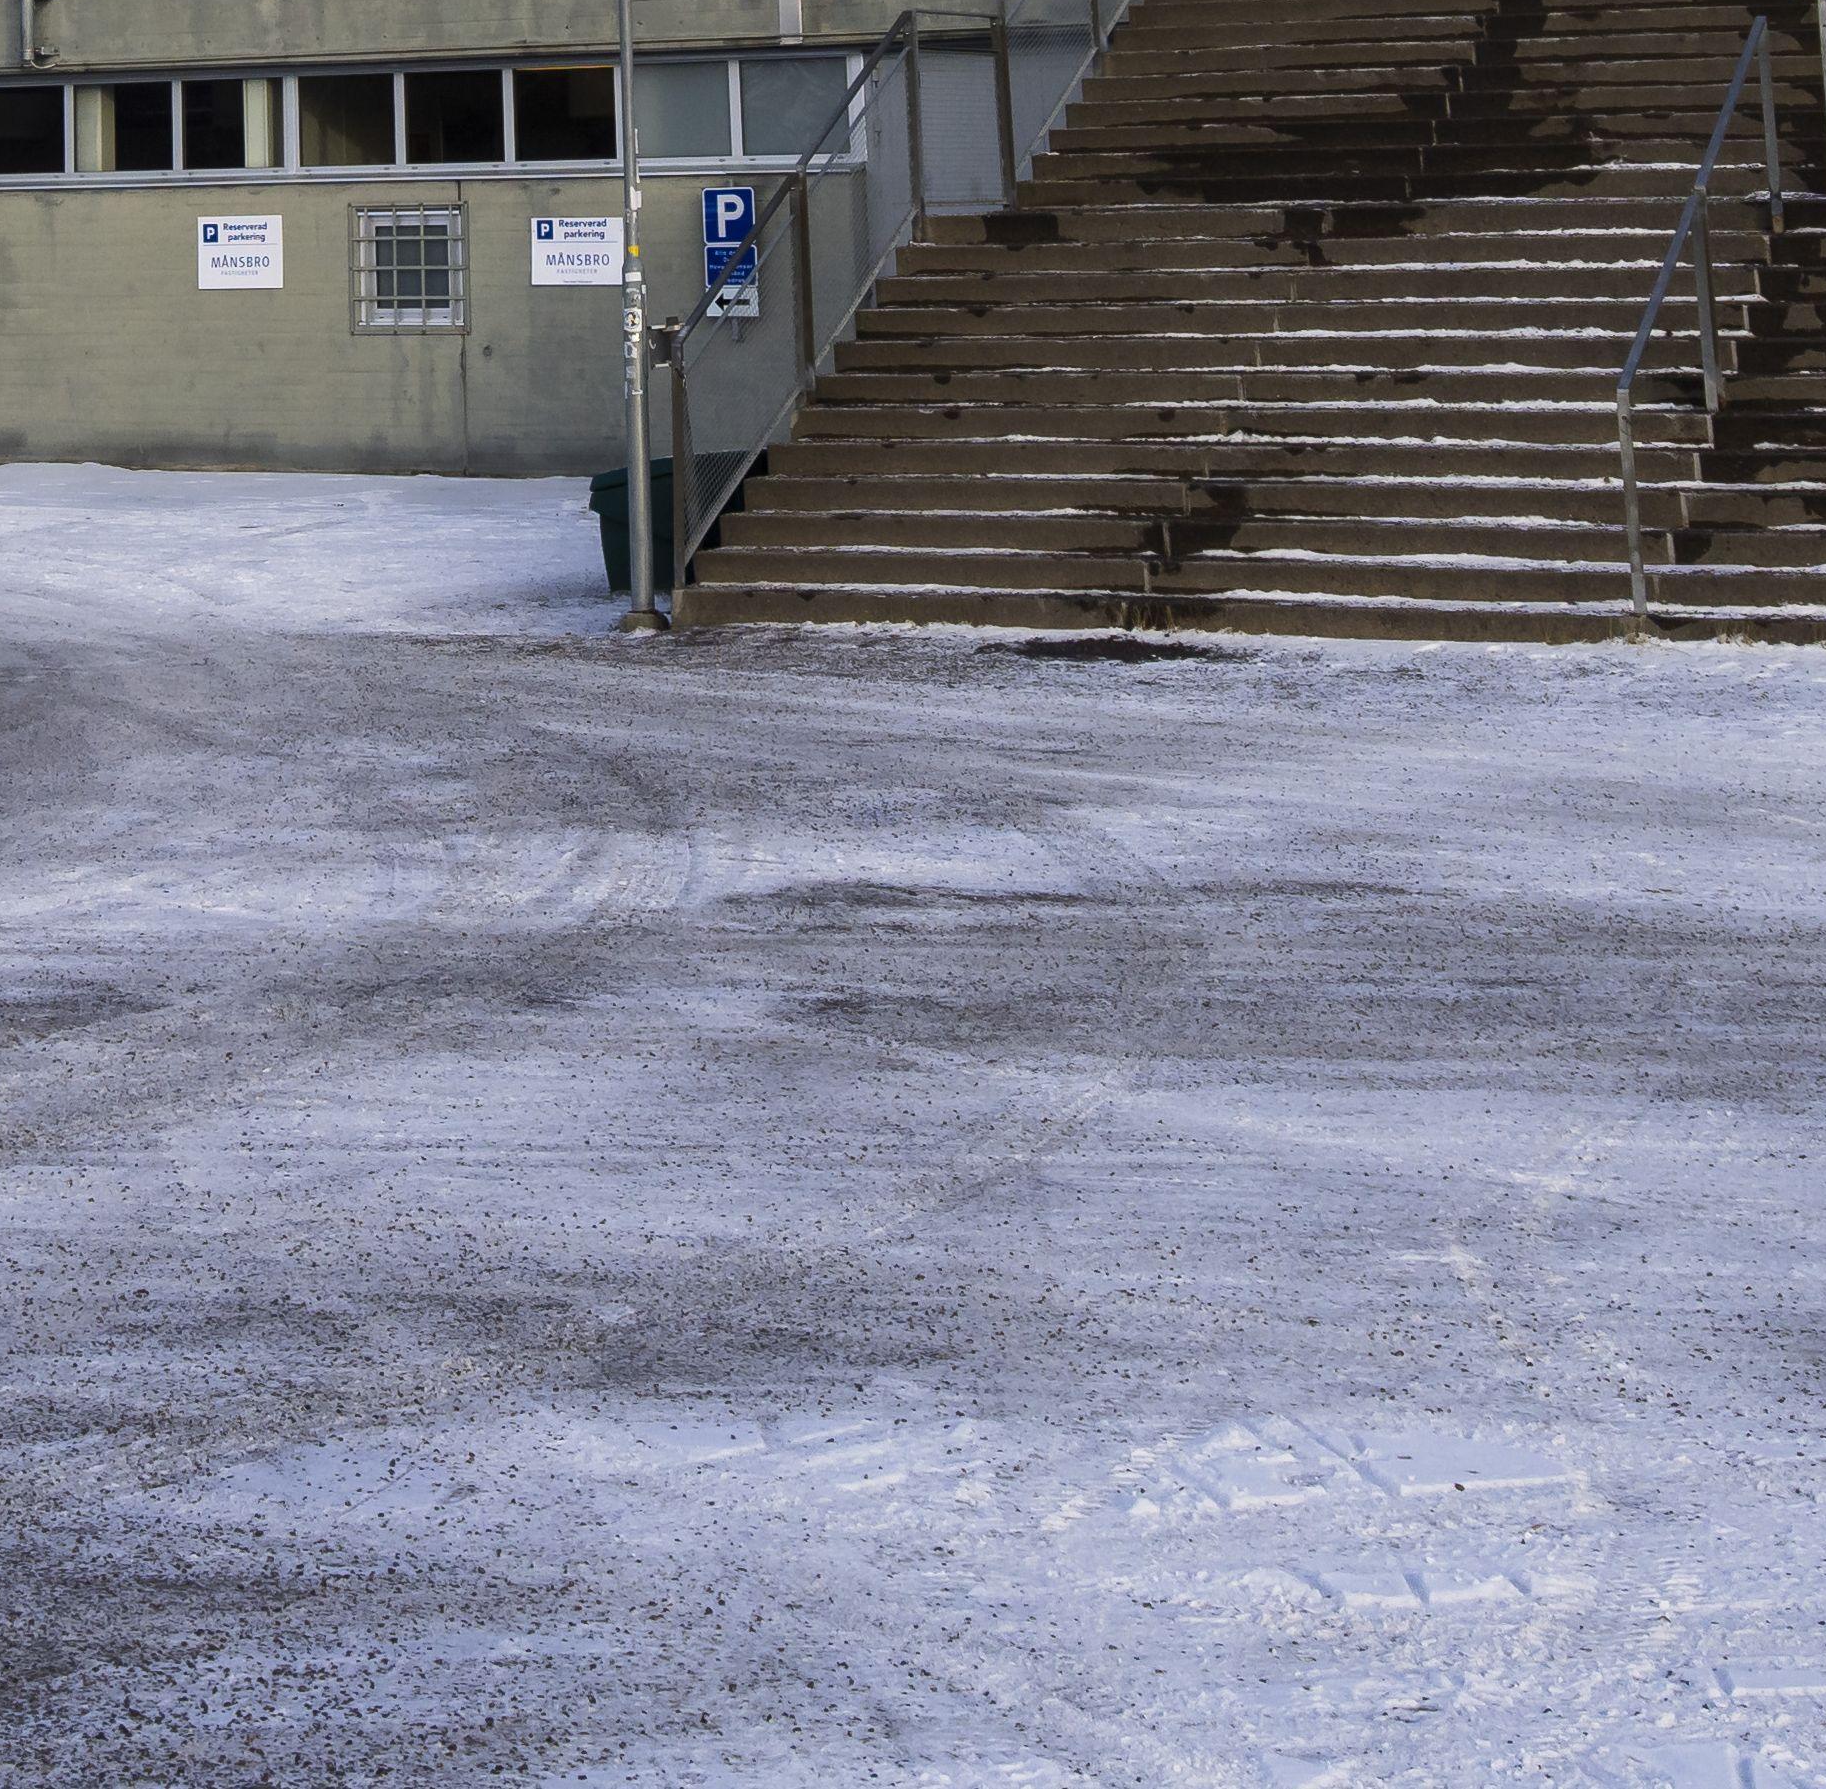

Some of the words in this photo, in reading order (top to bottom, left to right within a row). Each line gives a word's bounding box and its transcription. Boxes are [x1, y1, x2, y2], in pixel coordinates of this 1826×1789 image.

[716, 194, 745, 238] P
[206, 227, 215, 240] P
[223, 222, 268, 231] Reserverad
[541, 223, 550, 237] P
[558, 218, 607, 228] Reserverad
[563, 229, 605, 240] parkering
[228, 233, 266, 243] parkering
[211, 255, 270, 268] MÅNSBRO
[546, 252, 610, 266] MÅNSBRO
